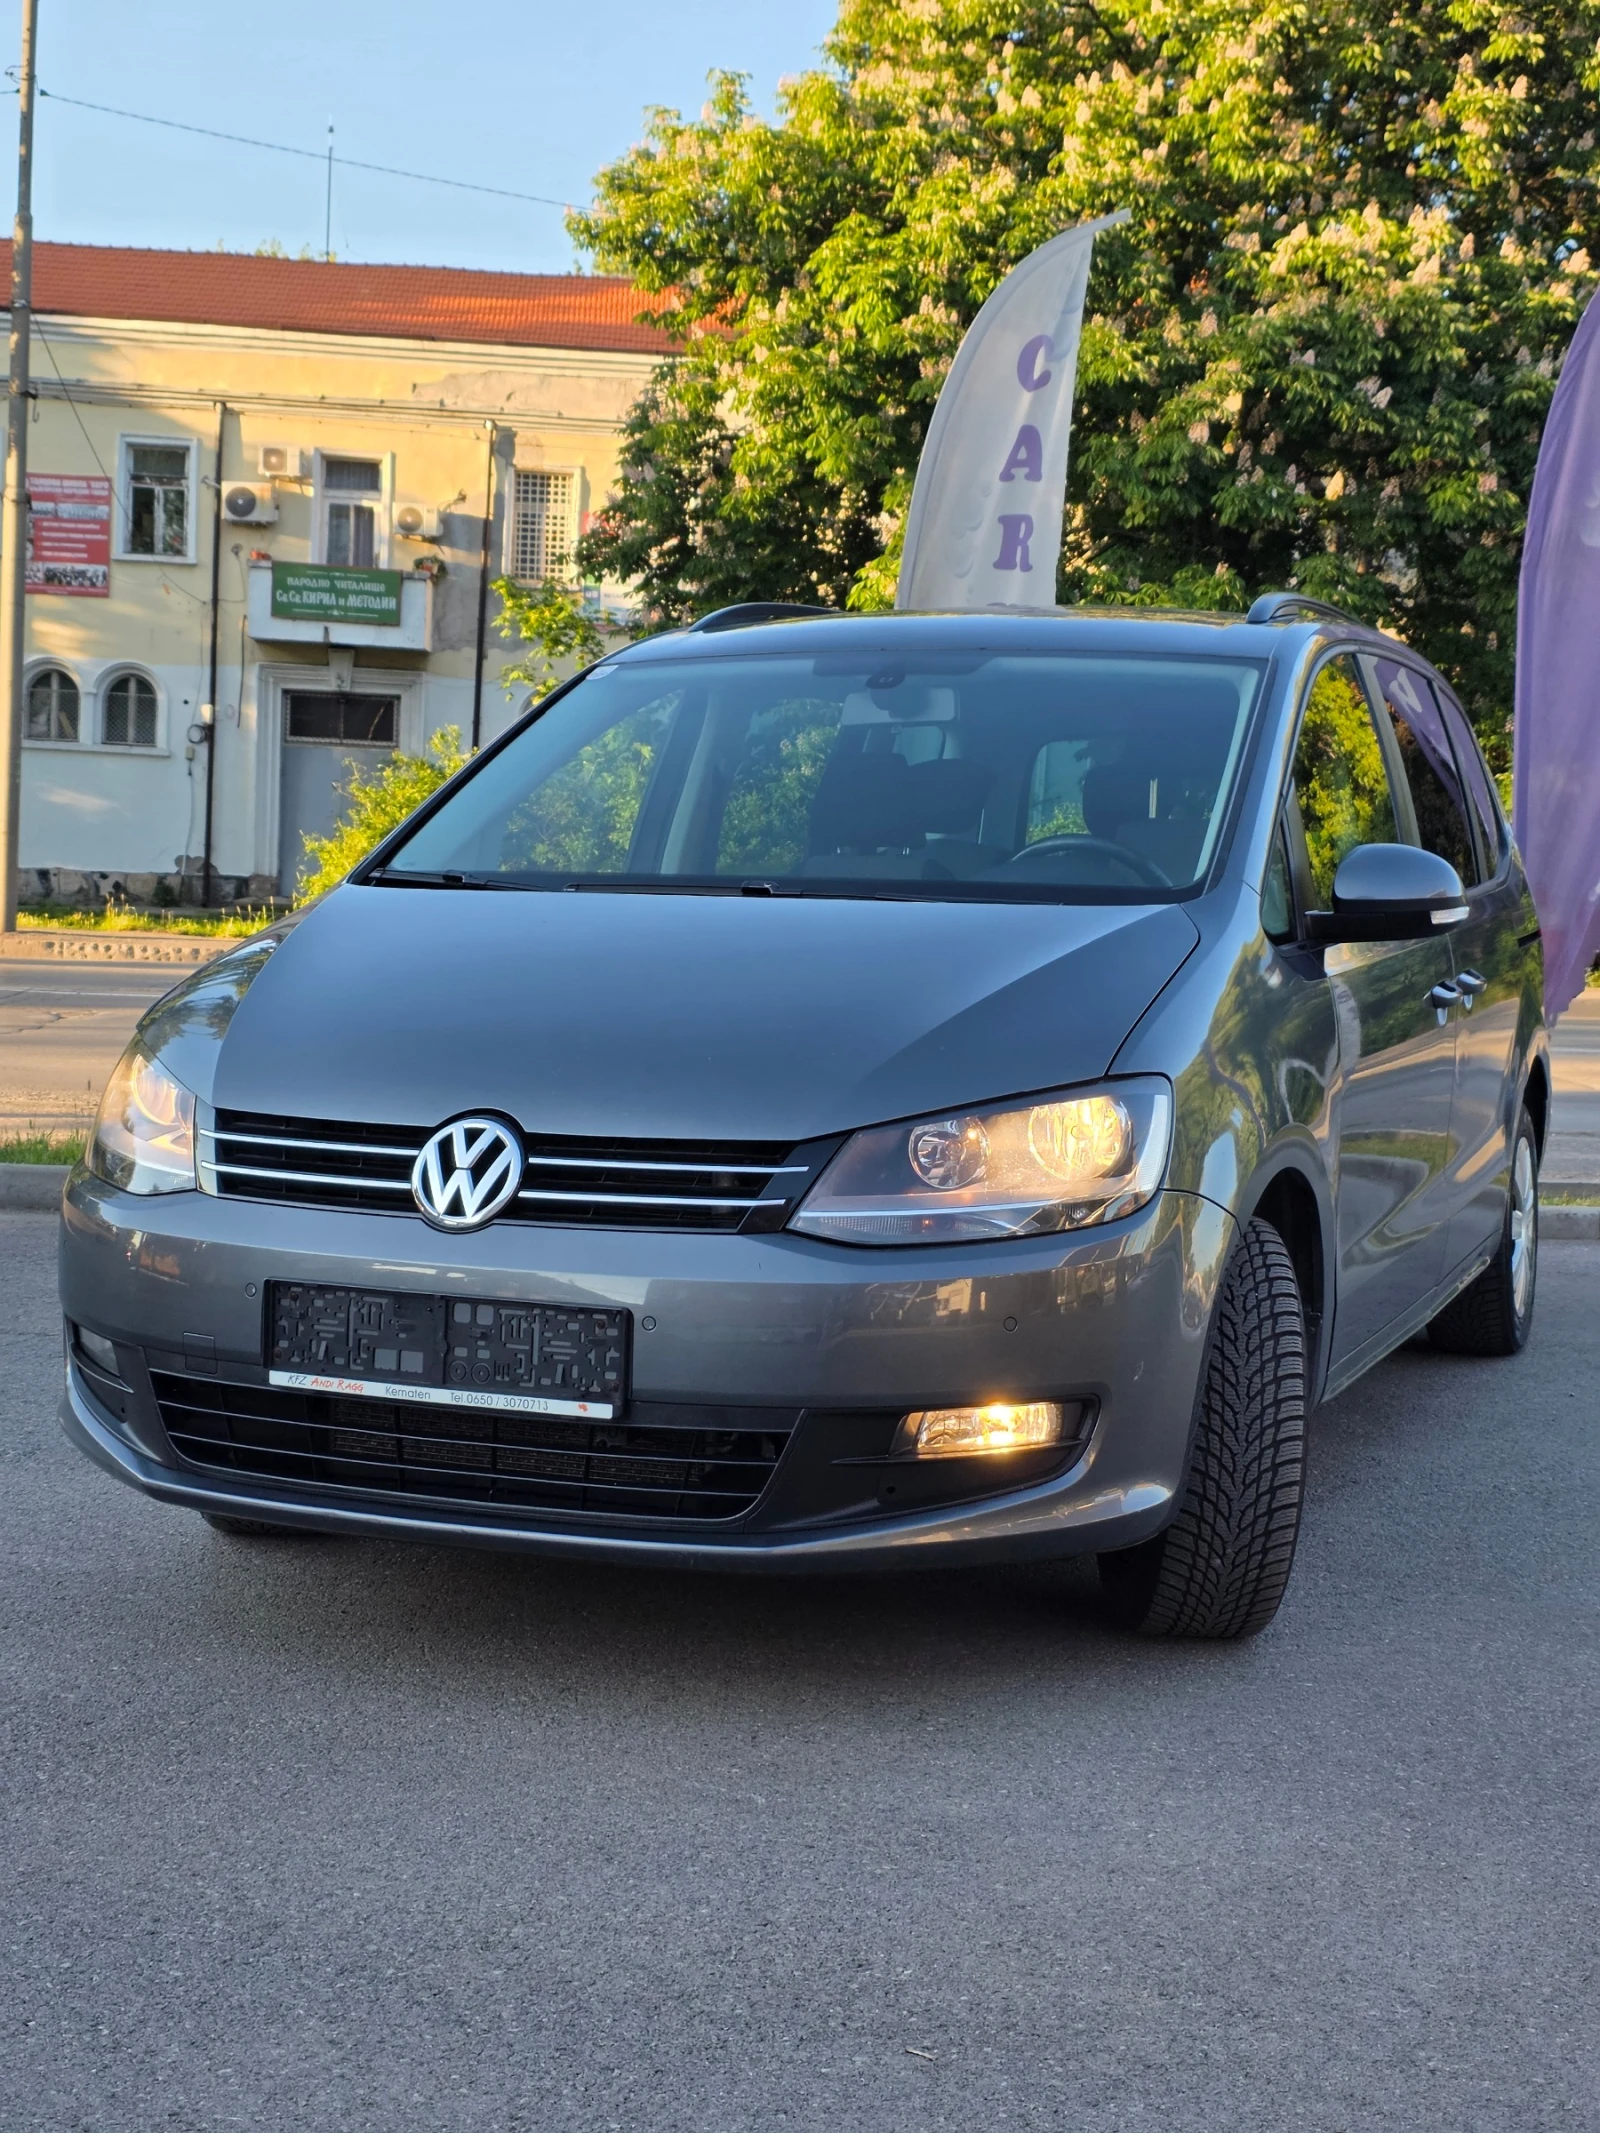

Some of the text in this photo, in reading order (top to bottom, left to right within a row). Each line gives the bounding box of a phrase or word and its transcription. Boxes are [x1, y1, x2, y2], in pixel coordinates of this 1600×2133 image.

[286, 577, 330, 588] НАРОДНО
[302, 591, 336, 606] КИРИЛ
[416, 1119, 517, 1221] VW
[287, 1375, 307, 1386] KFZ
[337, 1379, 364, 1393] RAGG
[503, 1398, 549, 1411] 3070713
